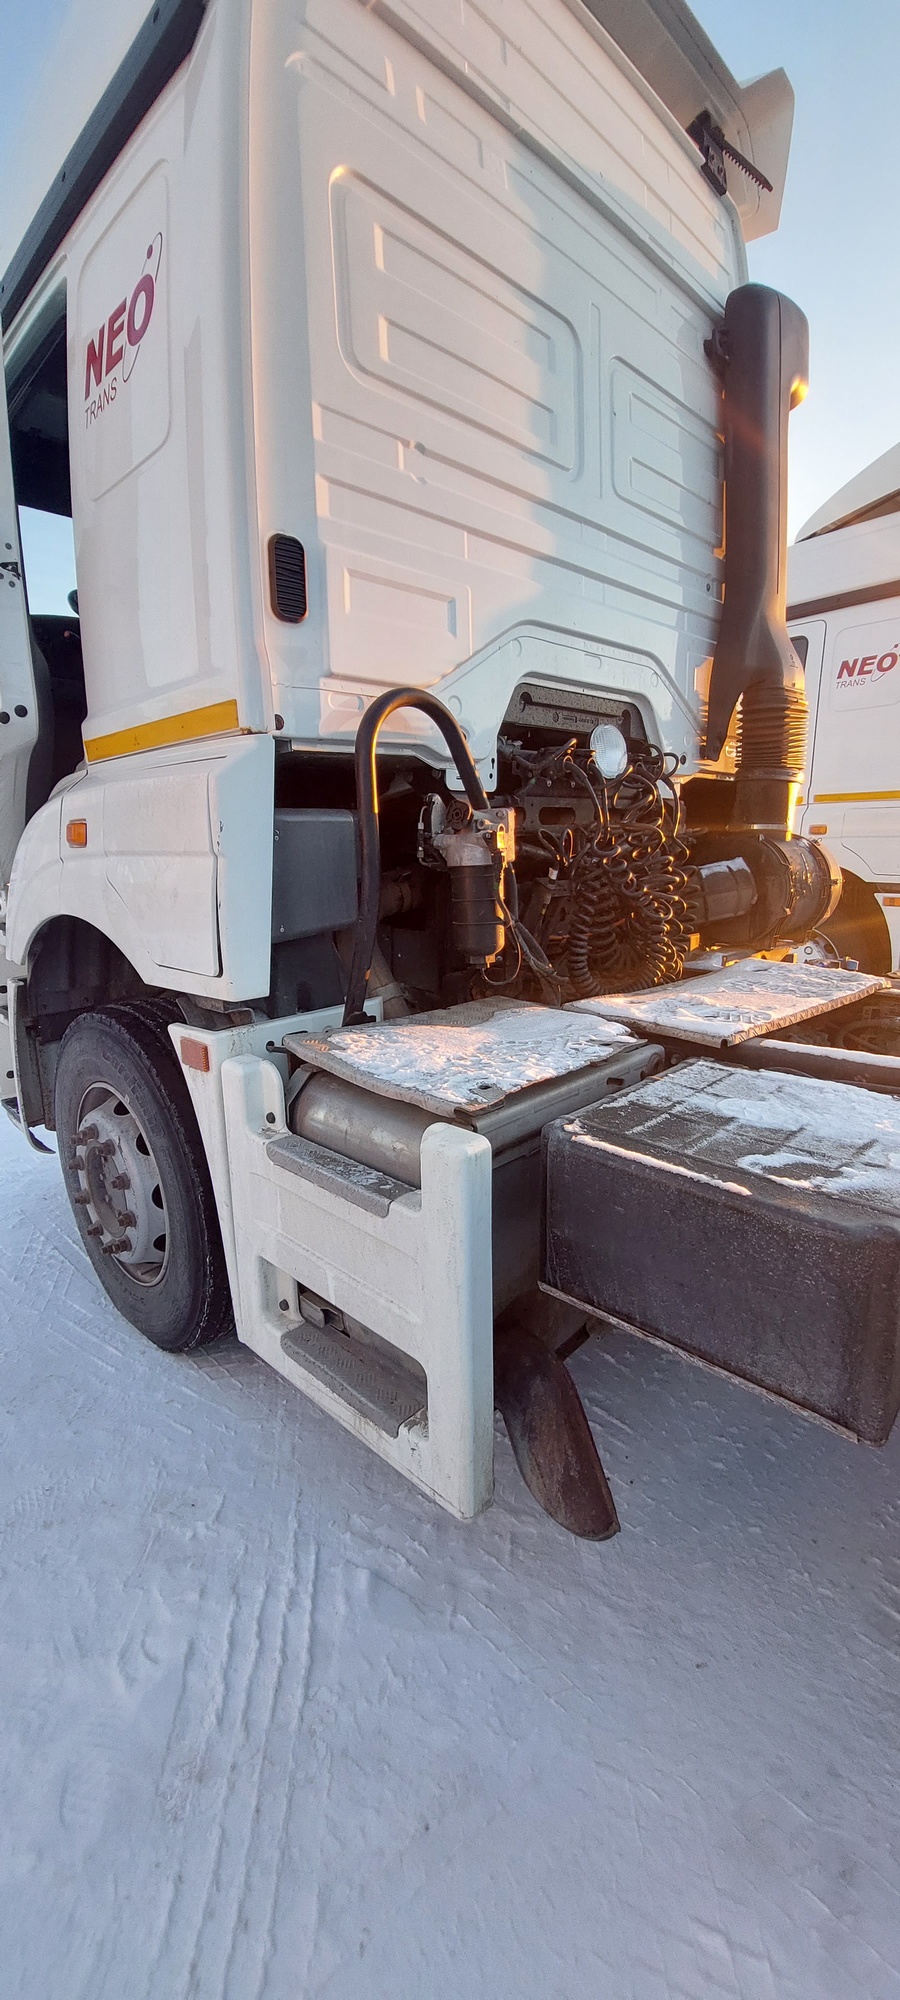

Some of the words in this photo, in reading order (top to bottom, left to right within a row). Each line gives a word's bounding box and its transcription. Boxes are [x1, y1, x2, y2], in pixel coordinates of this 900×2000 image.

[84, 273, 155, 401] NEO
[84, 377, 117, 429] TRANS
[835, 677, 867, 689] TRANS
[836, 652, 899, 680] NEO
